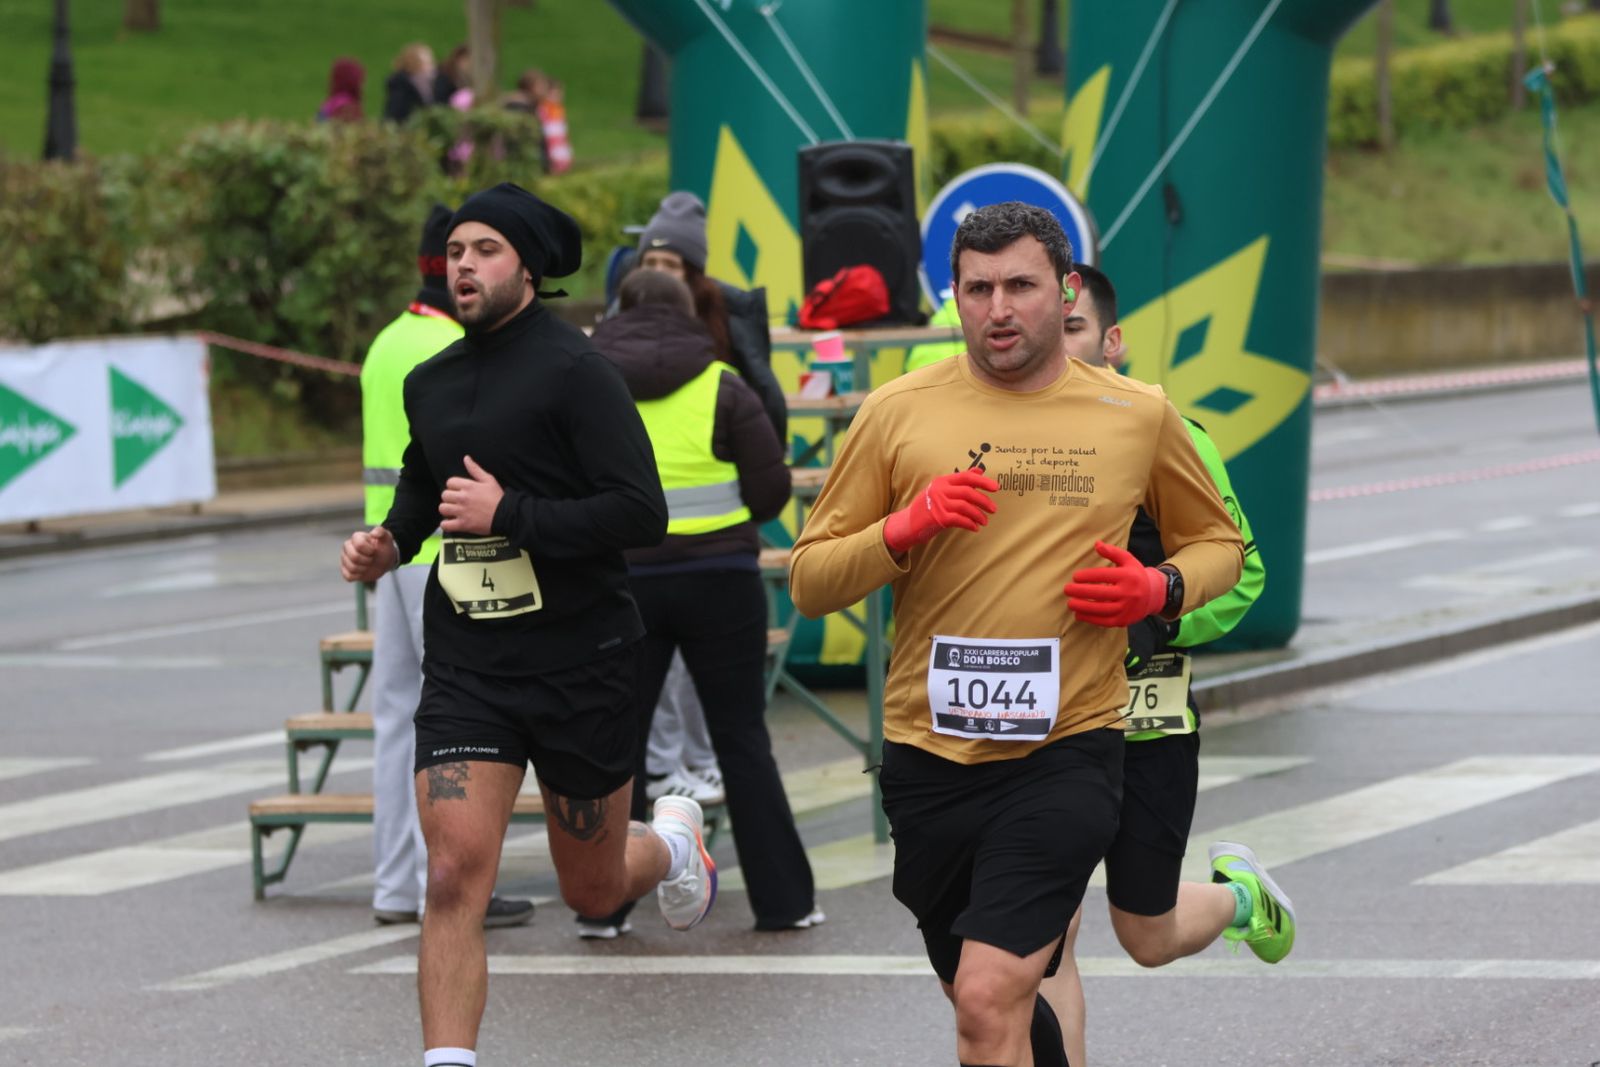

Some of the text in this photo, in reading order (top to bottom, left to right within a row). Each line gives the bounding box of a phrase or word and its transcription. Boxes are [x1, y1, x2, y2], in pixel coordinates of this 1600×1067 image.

[1031, 447, 1048, 458] por
[1068, 447, 1097, 455] salud
[1016, 460, 1022, 469] y
[1040, 458, 1079, 470] deporte
[997, 467, 1035, 496] colegio
[1052, 469, 1095, 493] médicos
[481, 568, 495, 592] 4
[963, 655, 1021, 665] DON BOSCO
[948, 678, 1037, 710] 1044
